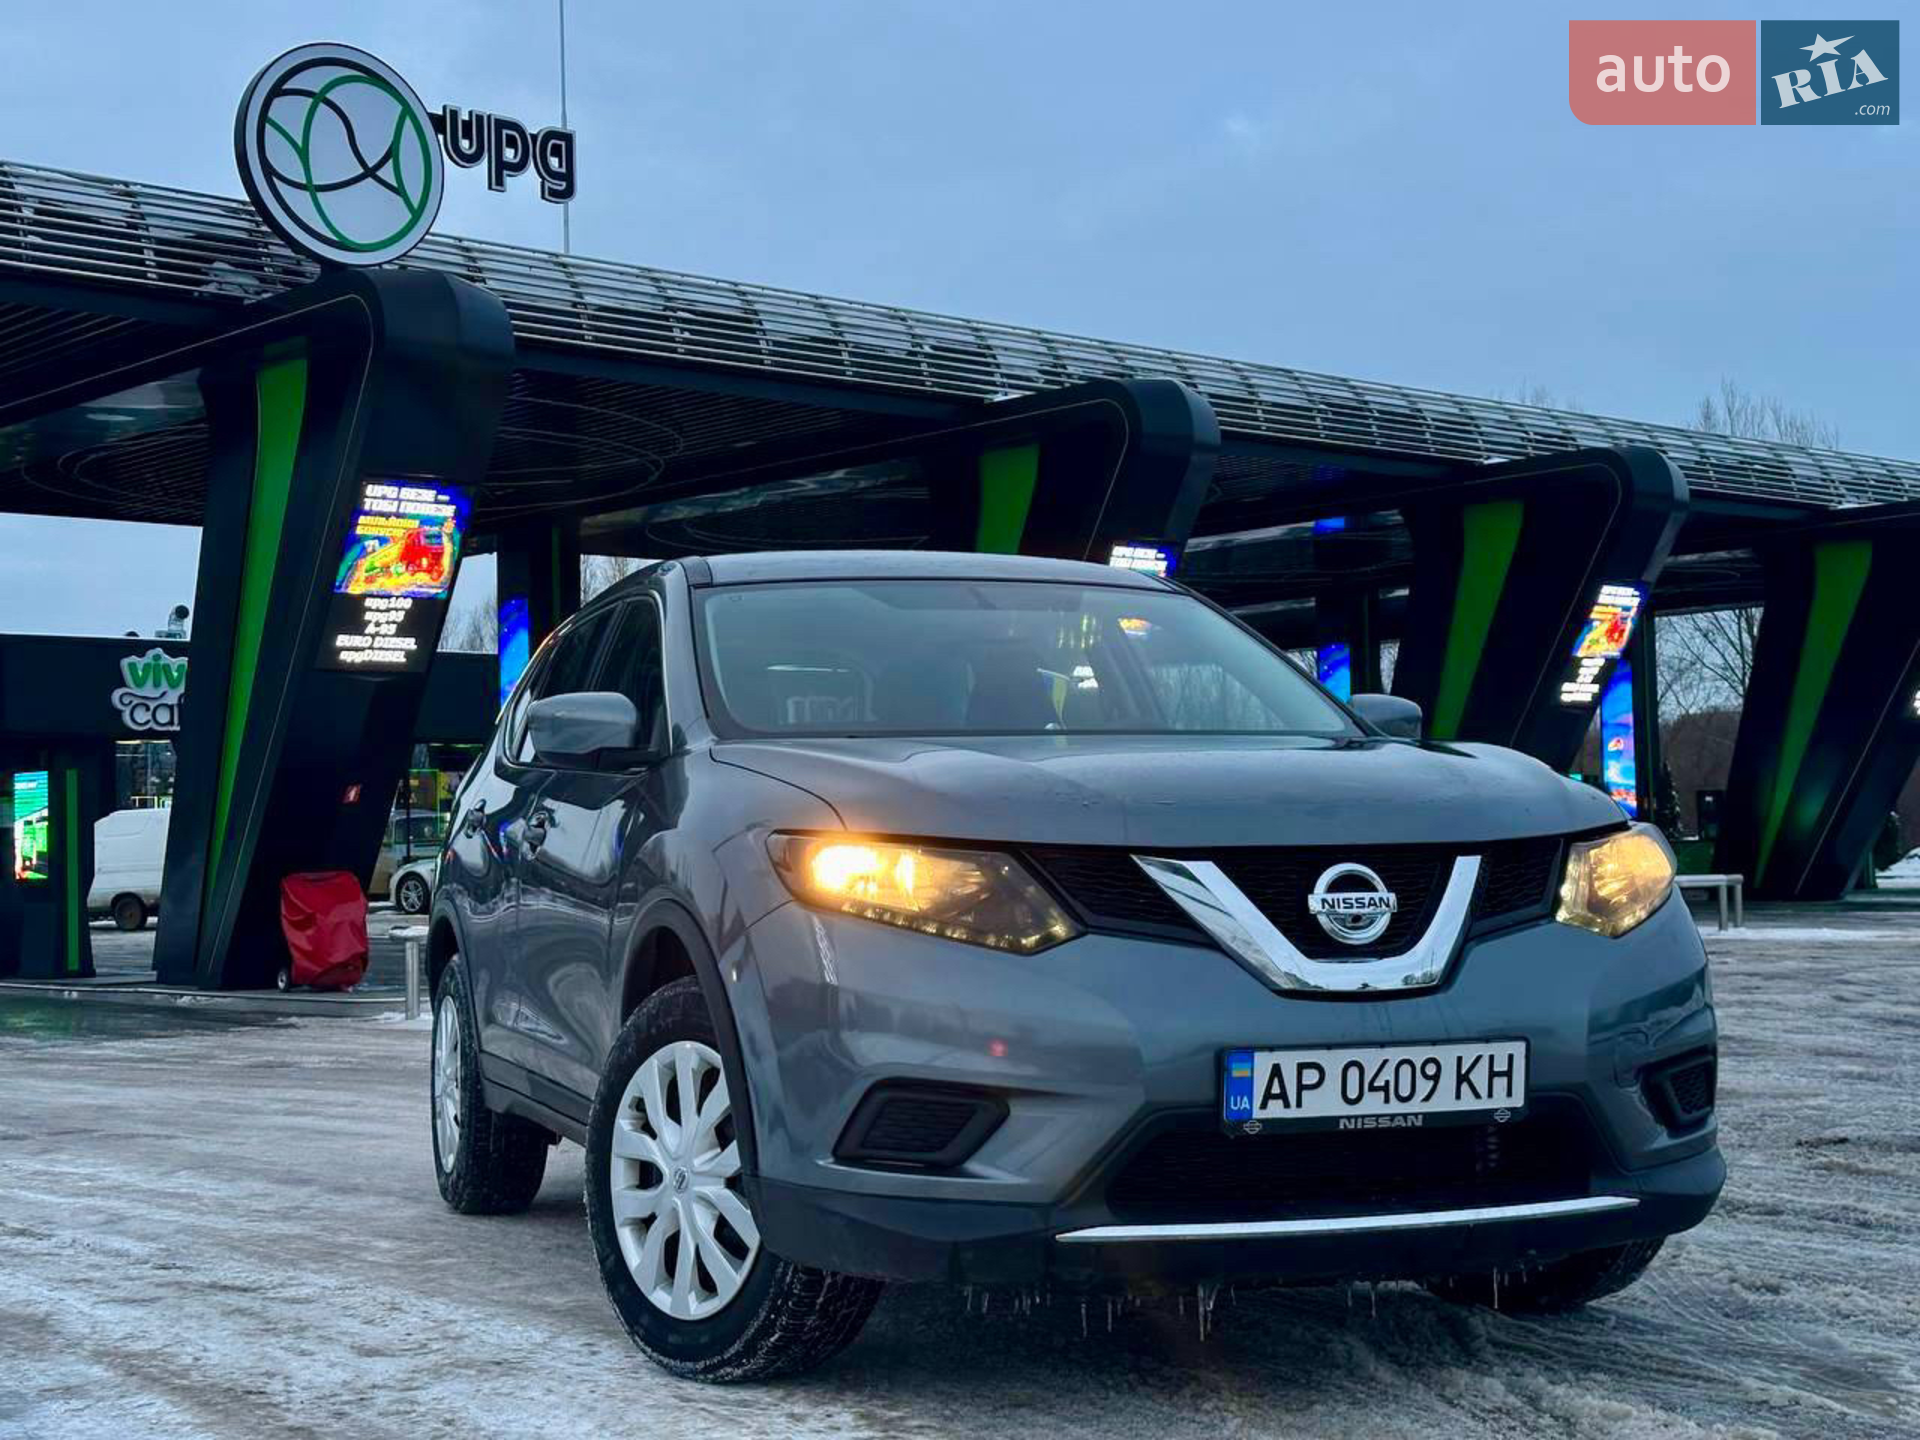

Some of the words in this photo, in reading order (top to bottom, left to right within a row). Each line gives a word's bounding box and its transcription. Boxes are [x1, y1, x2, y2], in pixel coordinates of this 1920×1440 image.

[442, 104, 577, 204] upg
[364, 597, 413, 610] upg100
[336, 635, 373, 648] EURO
[373, 636, 418, 650] DIESEL
[127, 653, 187, 690] viv
[120, 694, 180, 727] ca
[1320, 896, 1391, 910] NISSAN
[1258, 1062, 1326, 1110] AP
[1341, 1056, 1443, 1106] 0409
[1454, 1053, 1515, 1101] KH
[1230, 1095, 1251, 1112] UA
[1339, 1114, 1424, 1130] NISSAN
